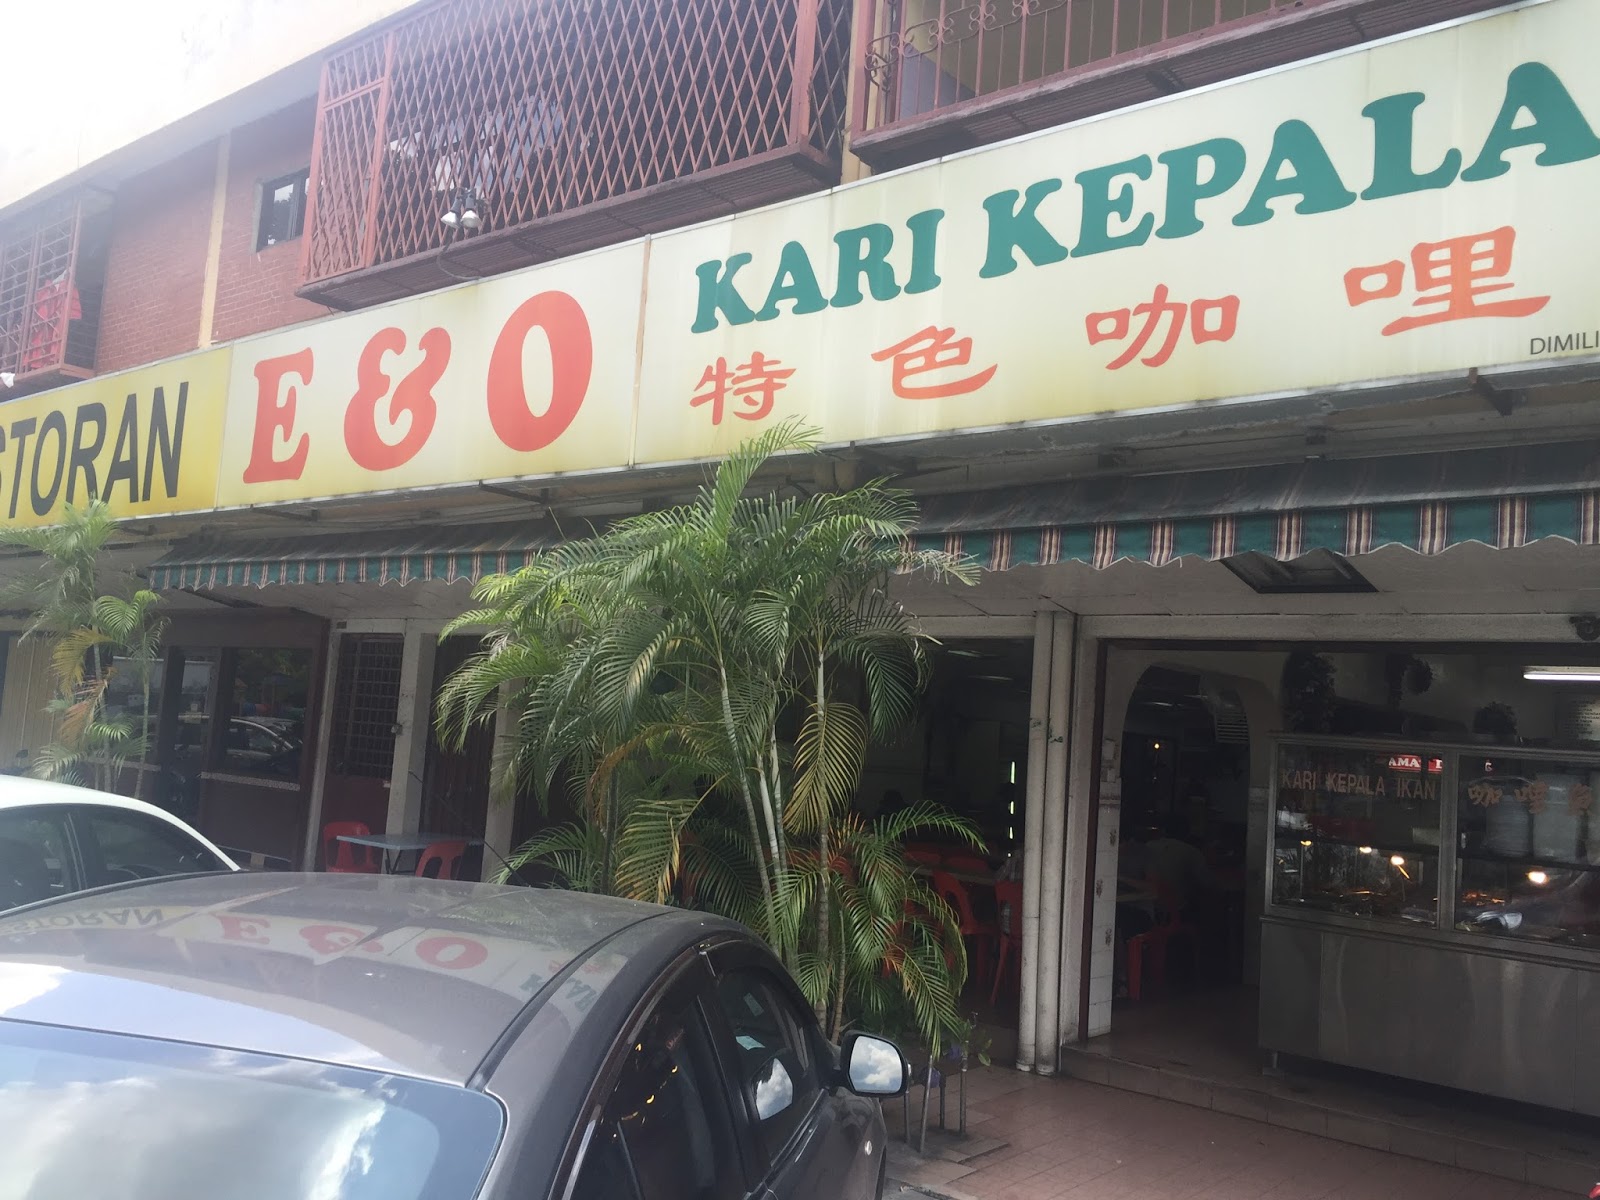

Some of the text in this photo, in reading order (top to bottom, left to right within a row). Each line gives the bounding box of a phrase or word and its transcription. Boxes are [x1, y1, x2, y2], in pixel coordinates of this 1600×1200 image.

[690, 61, 1600, 334] KARI KEPALA
[243, 290, 593, 484] E & O
[689, 225, 1551, 426] 特色咖哩
[1530, 330, 1600, 355] DIMILI
[0, 381, 189, 519] TORAN
[1280, 769, 1436, 800] KARI KEPALA IKAN
